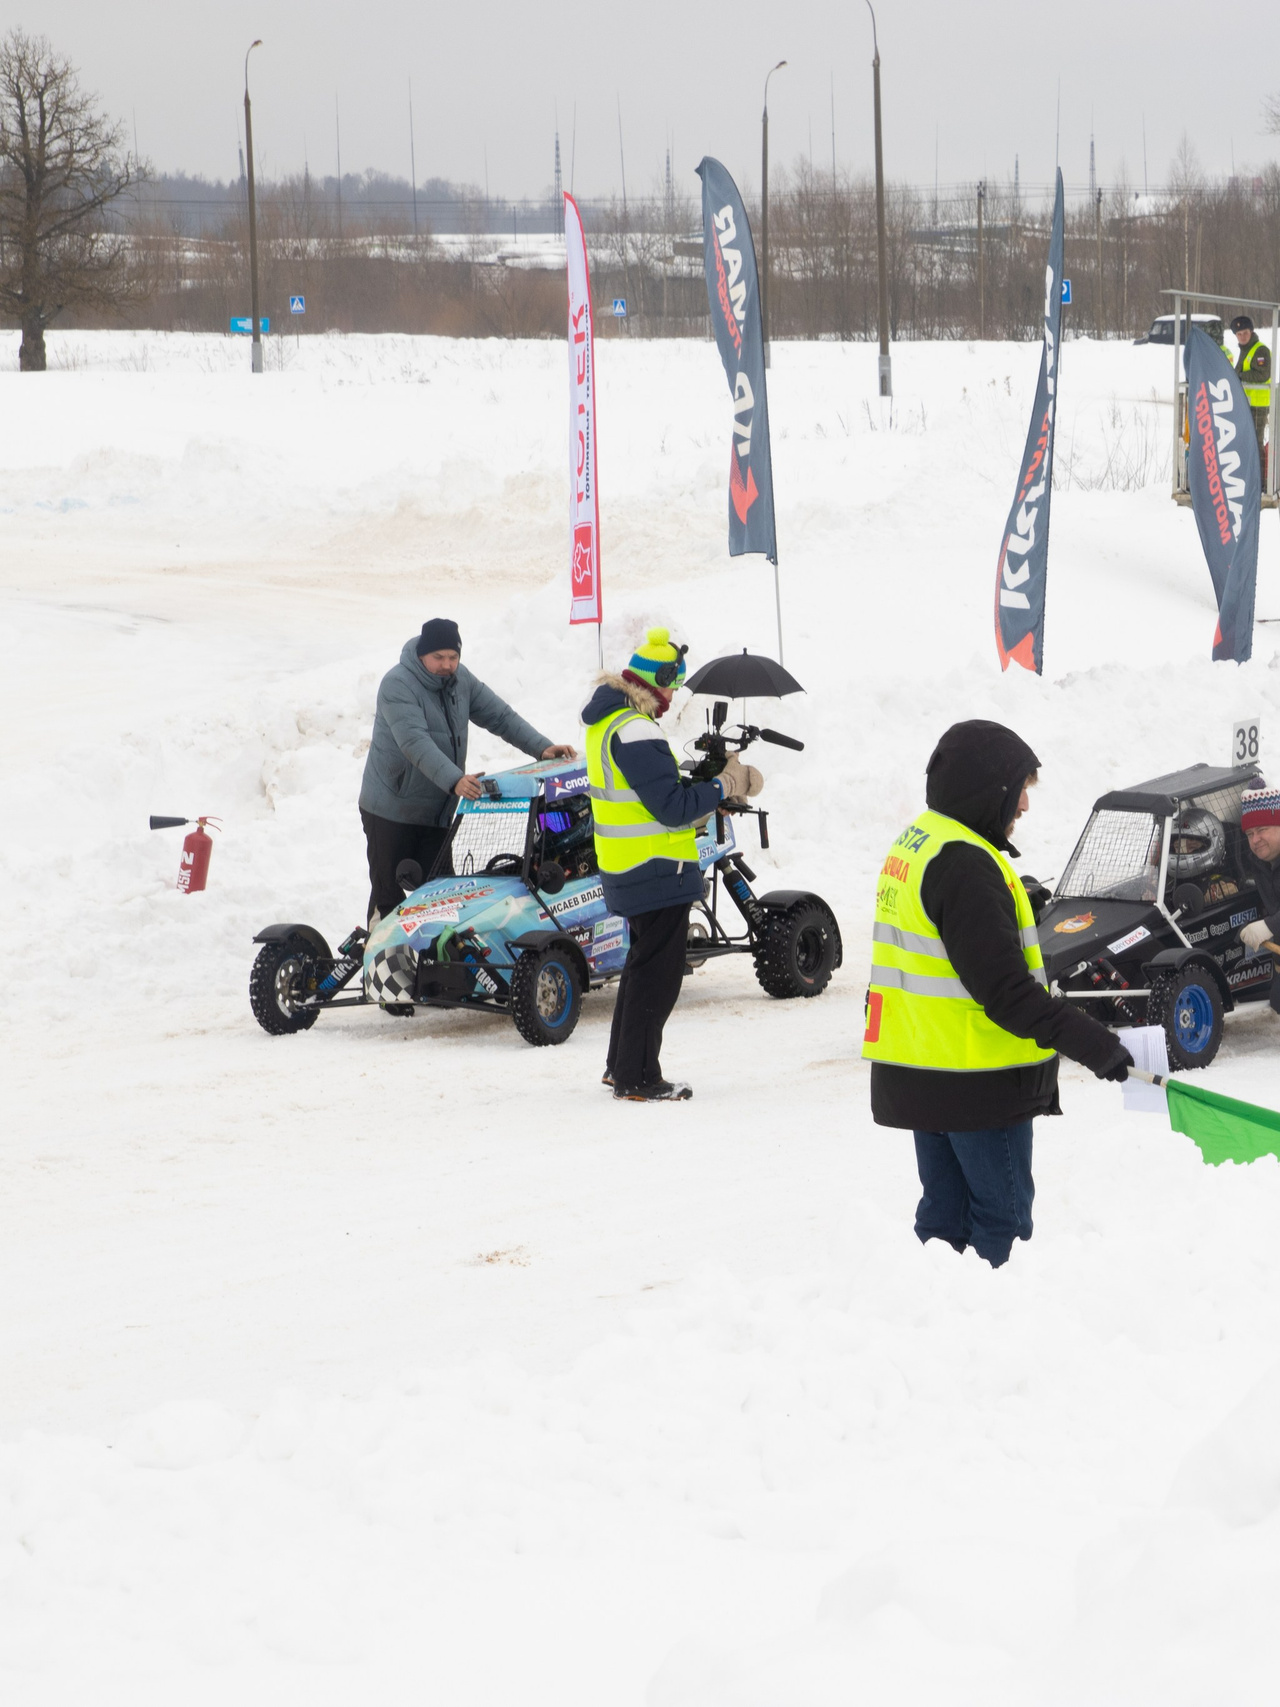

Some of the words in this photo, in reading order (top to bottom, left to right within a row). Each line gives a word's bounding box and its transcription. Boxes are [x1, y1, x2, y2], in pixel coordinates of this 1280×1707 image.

[1235, 725, 1259, 761] 38
[473, 800, 530, 811] Раменское
[1231, 908, 1257, 927] RUSTA
[592, 942, 615, 955] DRYDRY
[1111, 933, 1139, 953] DRYDRY
[1226, 962, 1272, 985] KRAMAR
